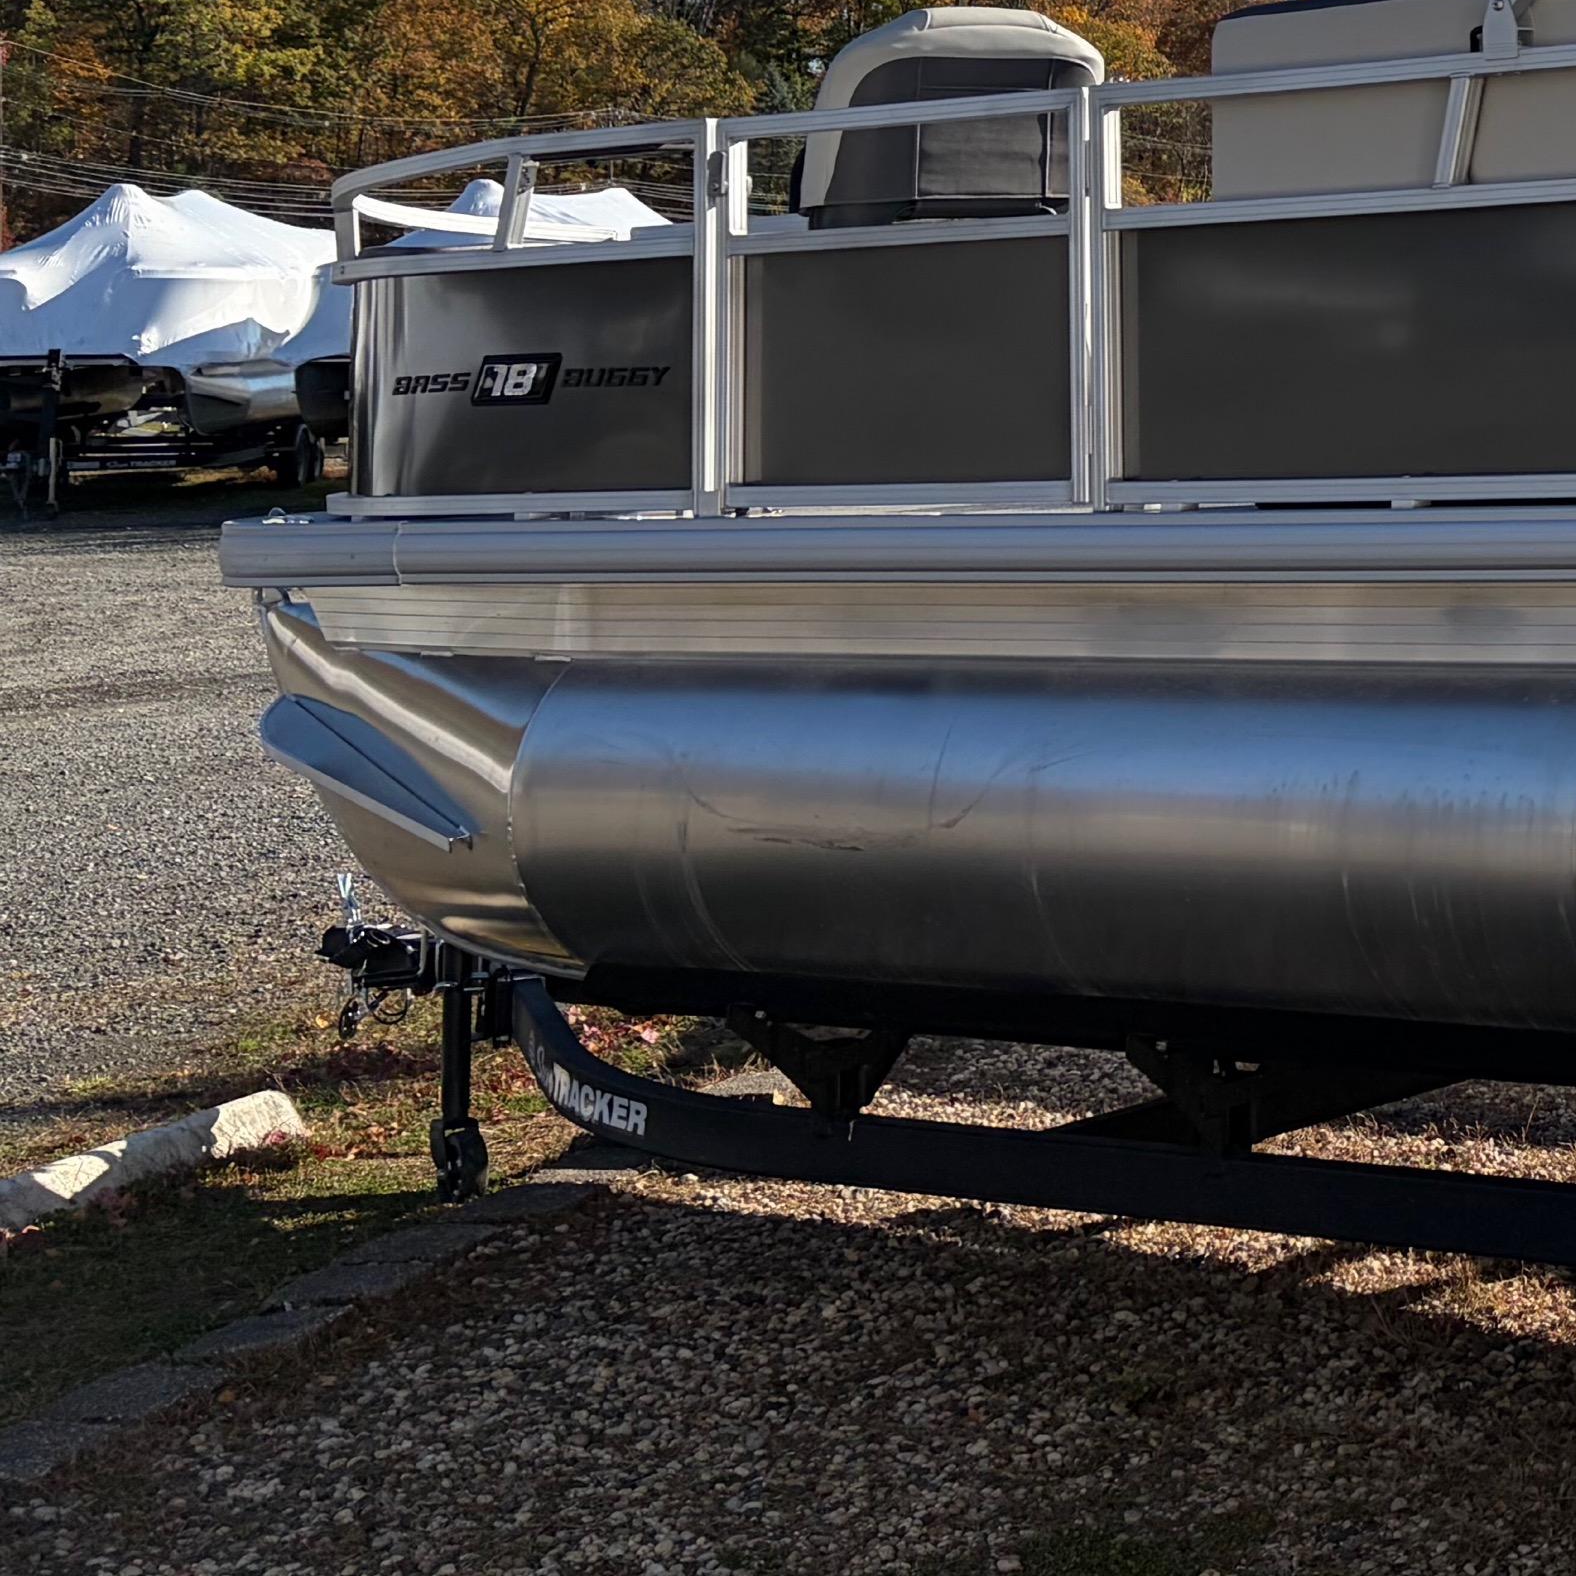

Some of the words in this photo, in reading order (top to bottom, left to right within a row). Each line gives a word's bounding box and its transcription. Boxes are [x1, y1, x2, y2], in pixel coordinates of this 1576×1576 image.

[391, 372, 472, 396] BASS
[490, 363, 537, 397] 18
[561, 367, 671, 388] BUGGY
[552, 1061, 648, 1137] TRACKER
